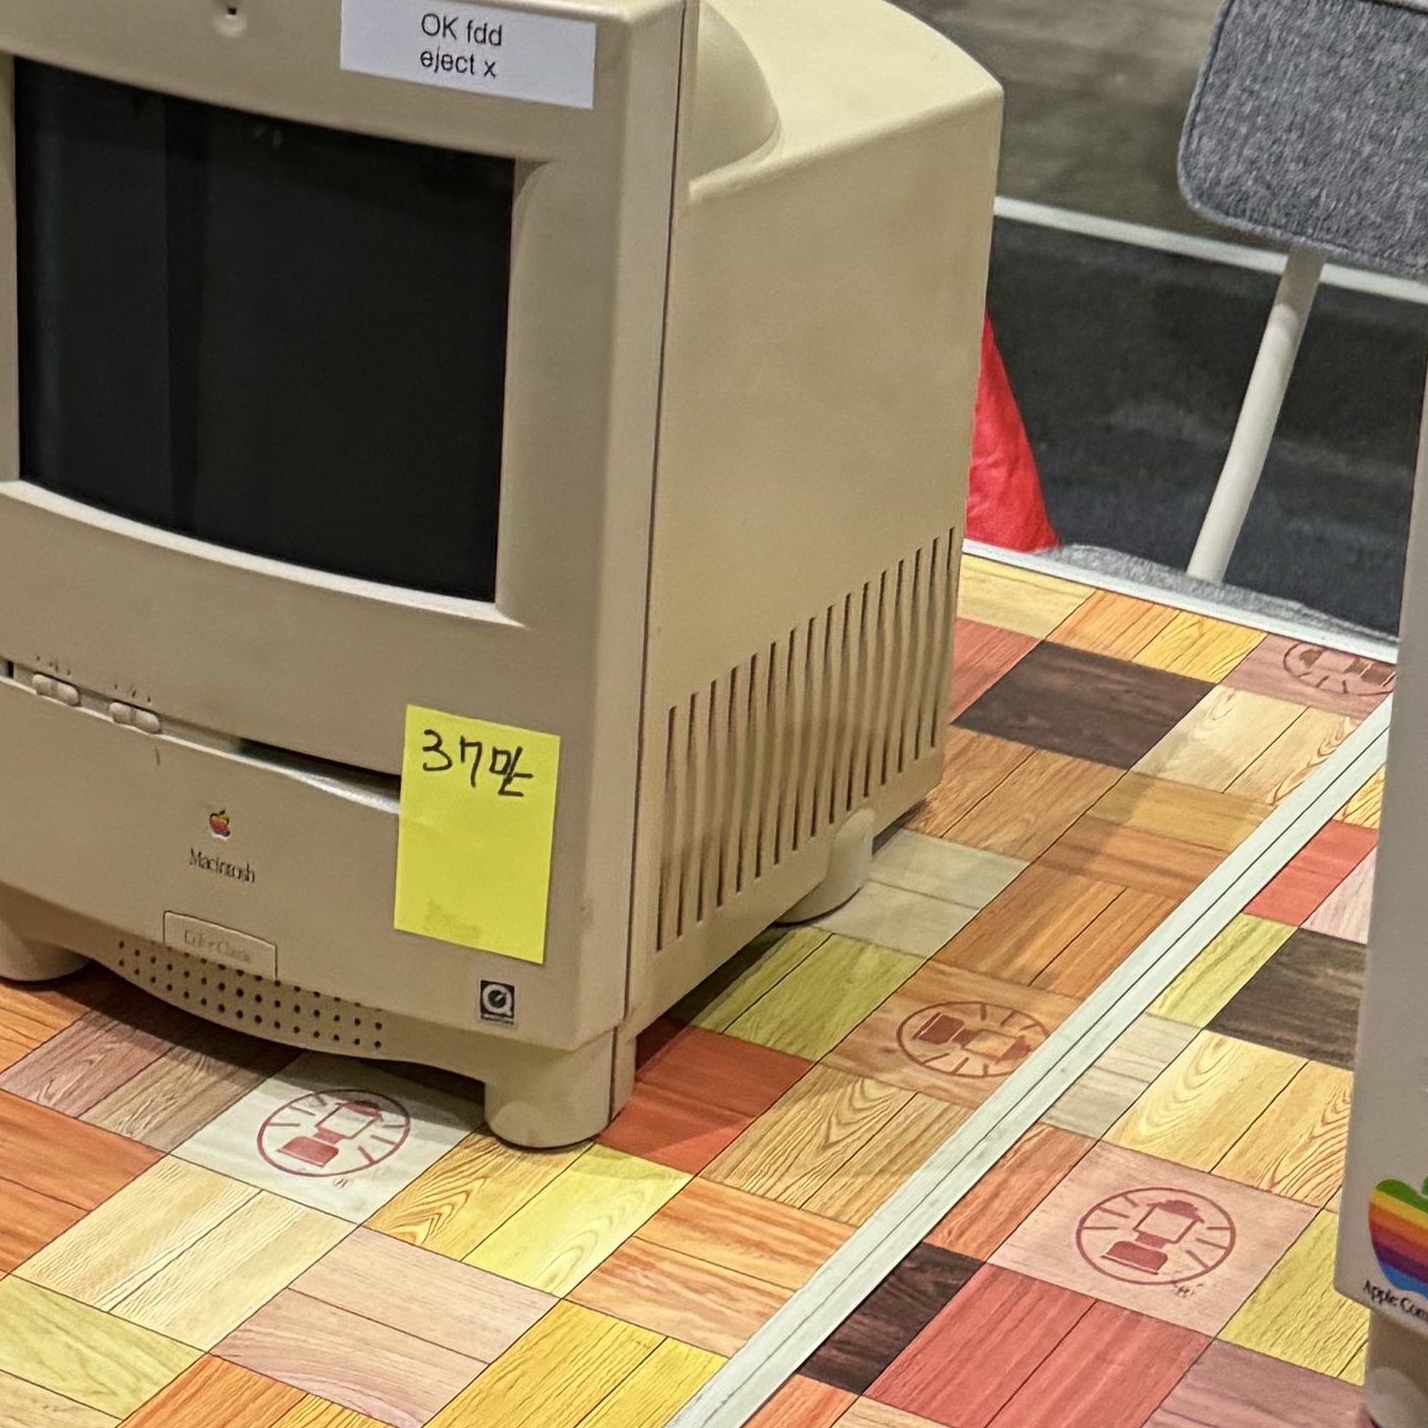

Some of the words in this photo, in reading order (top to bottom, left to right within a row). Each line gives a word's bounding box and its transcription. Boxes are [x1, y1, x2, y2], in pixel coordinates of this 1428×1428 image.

[421, 12, 459, 42] OK
[466, 19, 503, 47] fdd
[420, 45, 475, 76] eject
[422, 728, 534, 798] 37만
[1362, 1279, 1400, 1307] Apple
